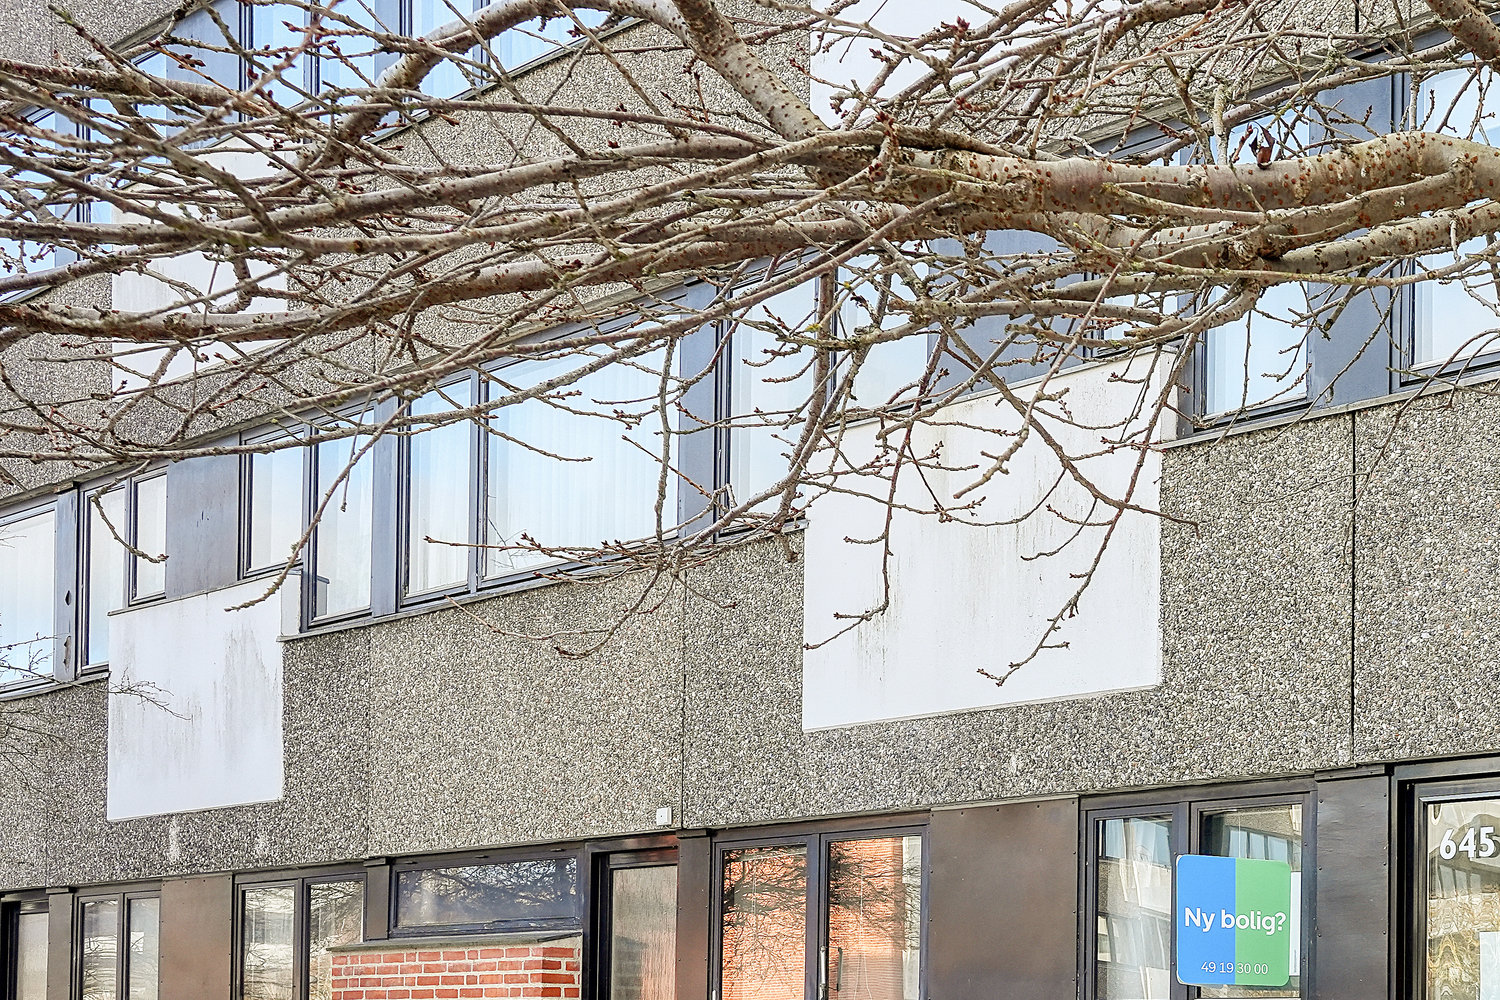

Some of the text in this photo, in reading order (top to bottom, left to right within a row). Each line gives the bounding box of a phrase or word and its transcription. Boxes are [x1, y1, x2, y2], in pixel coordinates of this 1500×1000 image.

[1439, 826, 1495, 860] 645
[1184, 907, 1287, 935] Ny bolig?
[1201, 961, 1269, 975] 49 19 30 00
